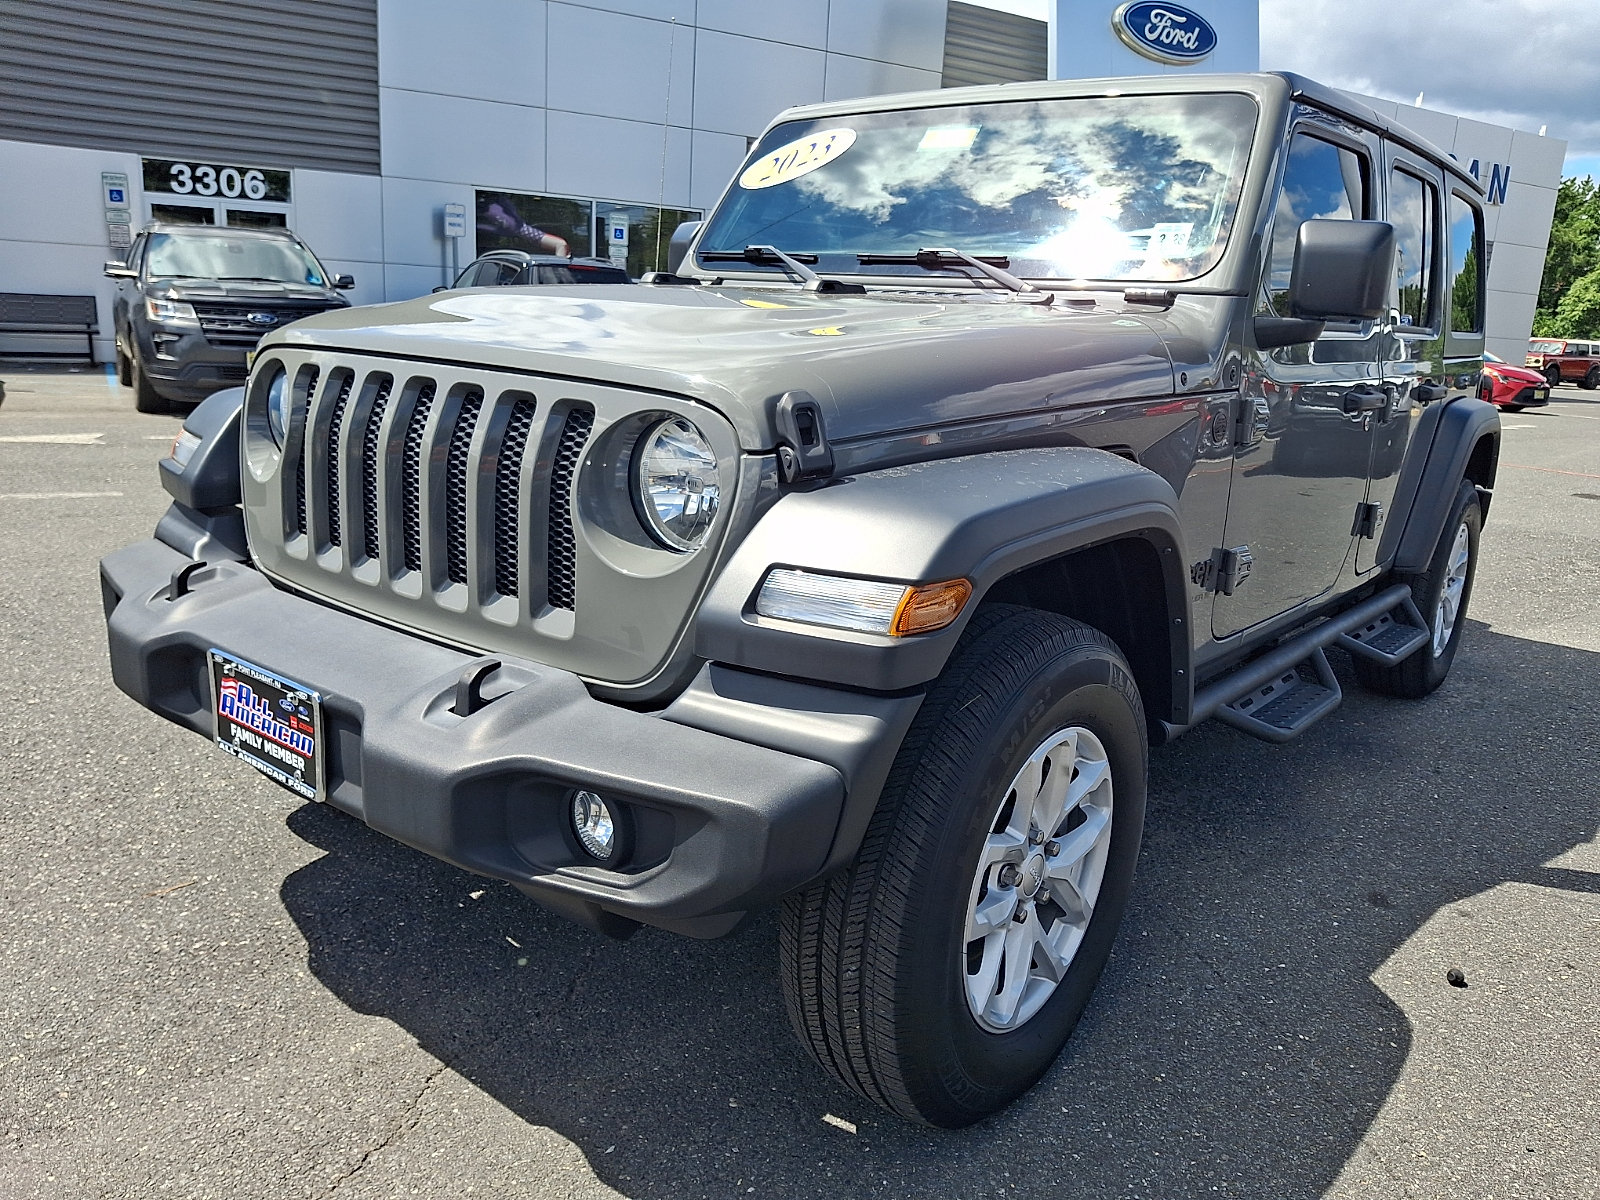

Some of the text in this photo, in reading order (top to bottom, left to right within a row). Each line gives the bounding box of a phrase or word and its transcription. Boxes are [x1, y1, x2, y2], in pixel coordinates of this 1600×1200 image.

[1144, 8, 1200, 50] Ford
[169, 163, 267, 200] 3306
[237, 664, 251, 677] POINT
[237, 683, 273, 718] ALL
[220, 694, 314, 757] AMERICAN
[230, 723, 263, 750] FAMILY
[264, 740, 306, 771] MEMBER
[219, 742, 315, 799] ALL AMERICAN FORD
